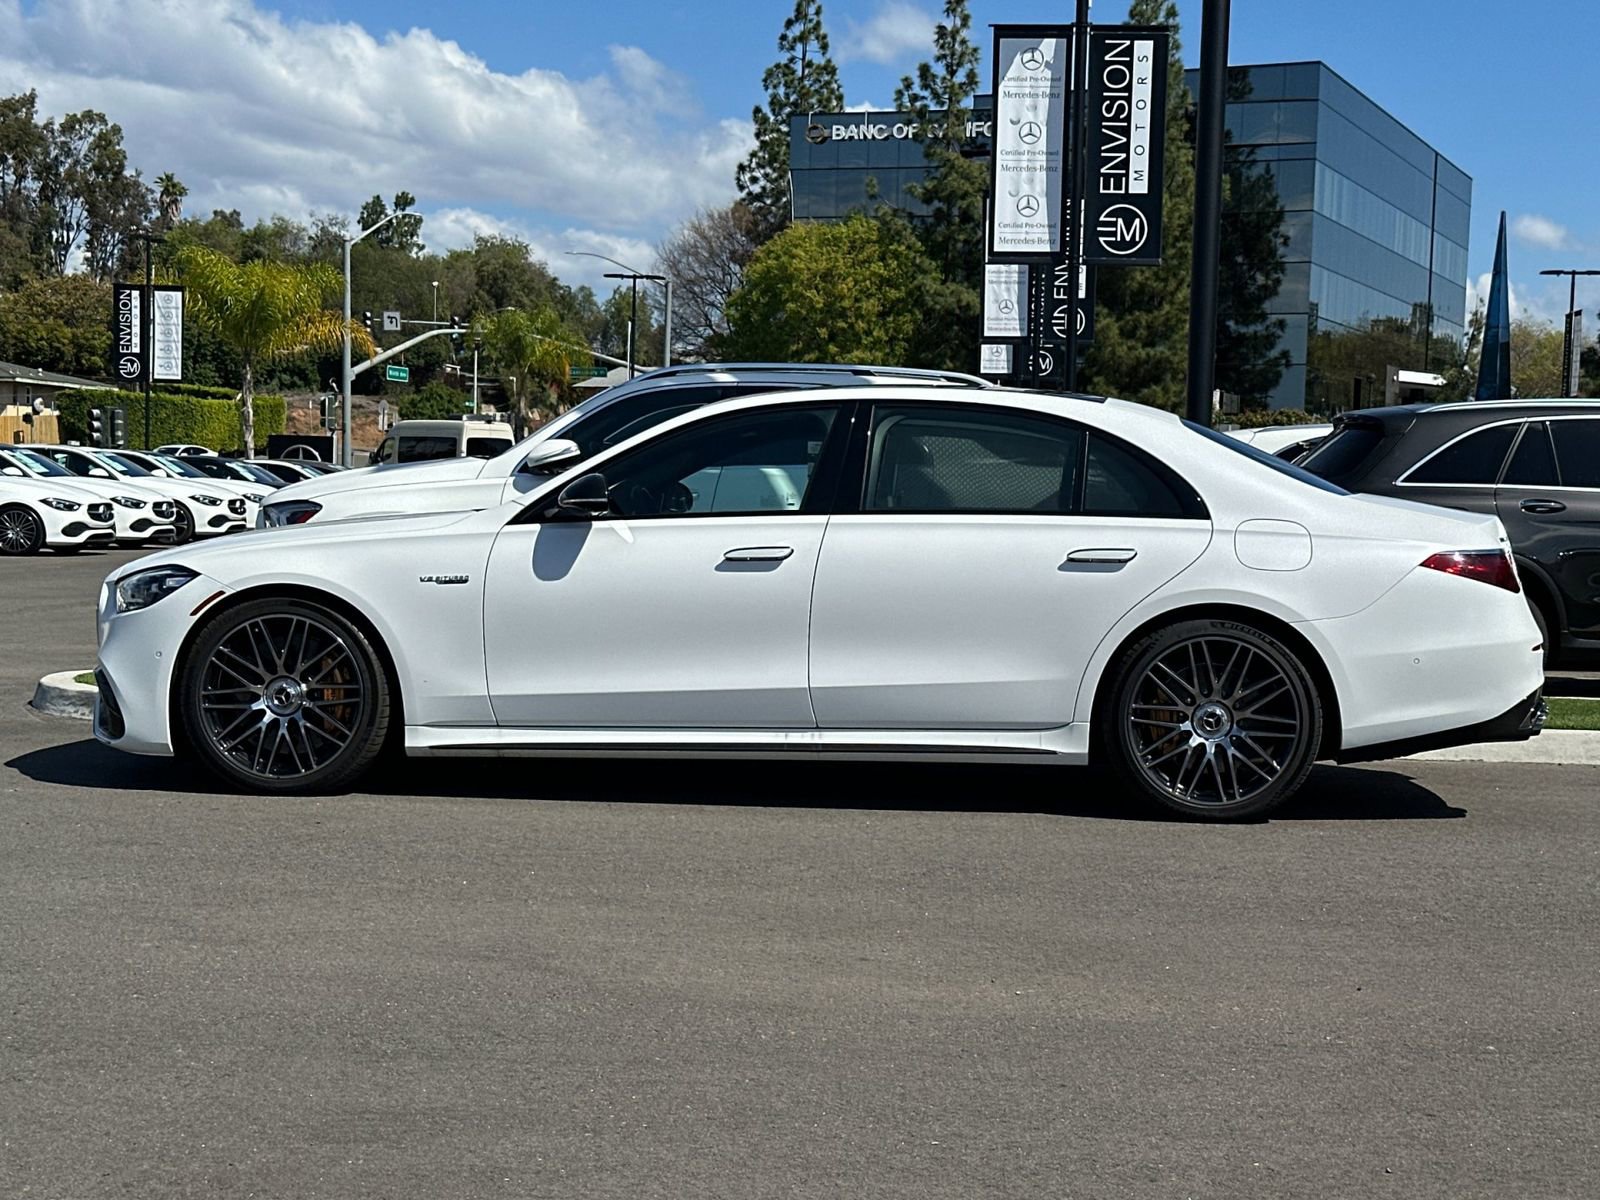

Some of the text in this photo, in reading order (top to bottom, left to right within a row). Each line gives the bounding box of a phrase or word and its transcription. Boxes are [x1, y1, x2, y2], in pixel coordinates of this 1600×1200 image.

[1002, 90, 1061, 99] Mercedes-Benz
[1100, 39, 1131, 194] ENVISION
[1133, 55, 1149, 181] MOTORS
[831, 124, 888, 140] BANC
[892, 123, 919, 139] OF
[1000, 164, 1058, 173] Mercedes-Benz
[998, 236, 1056, 245] Mercedes-Benz
[119, 289, 131, 353] ENVISION
